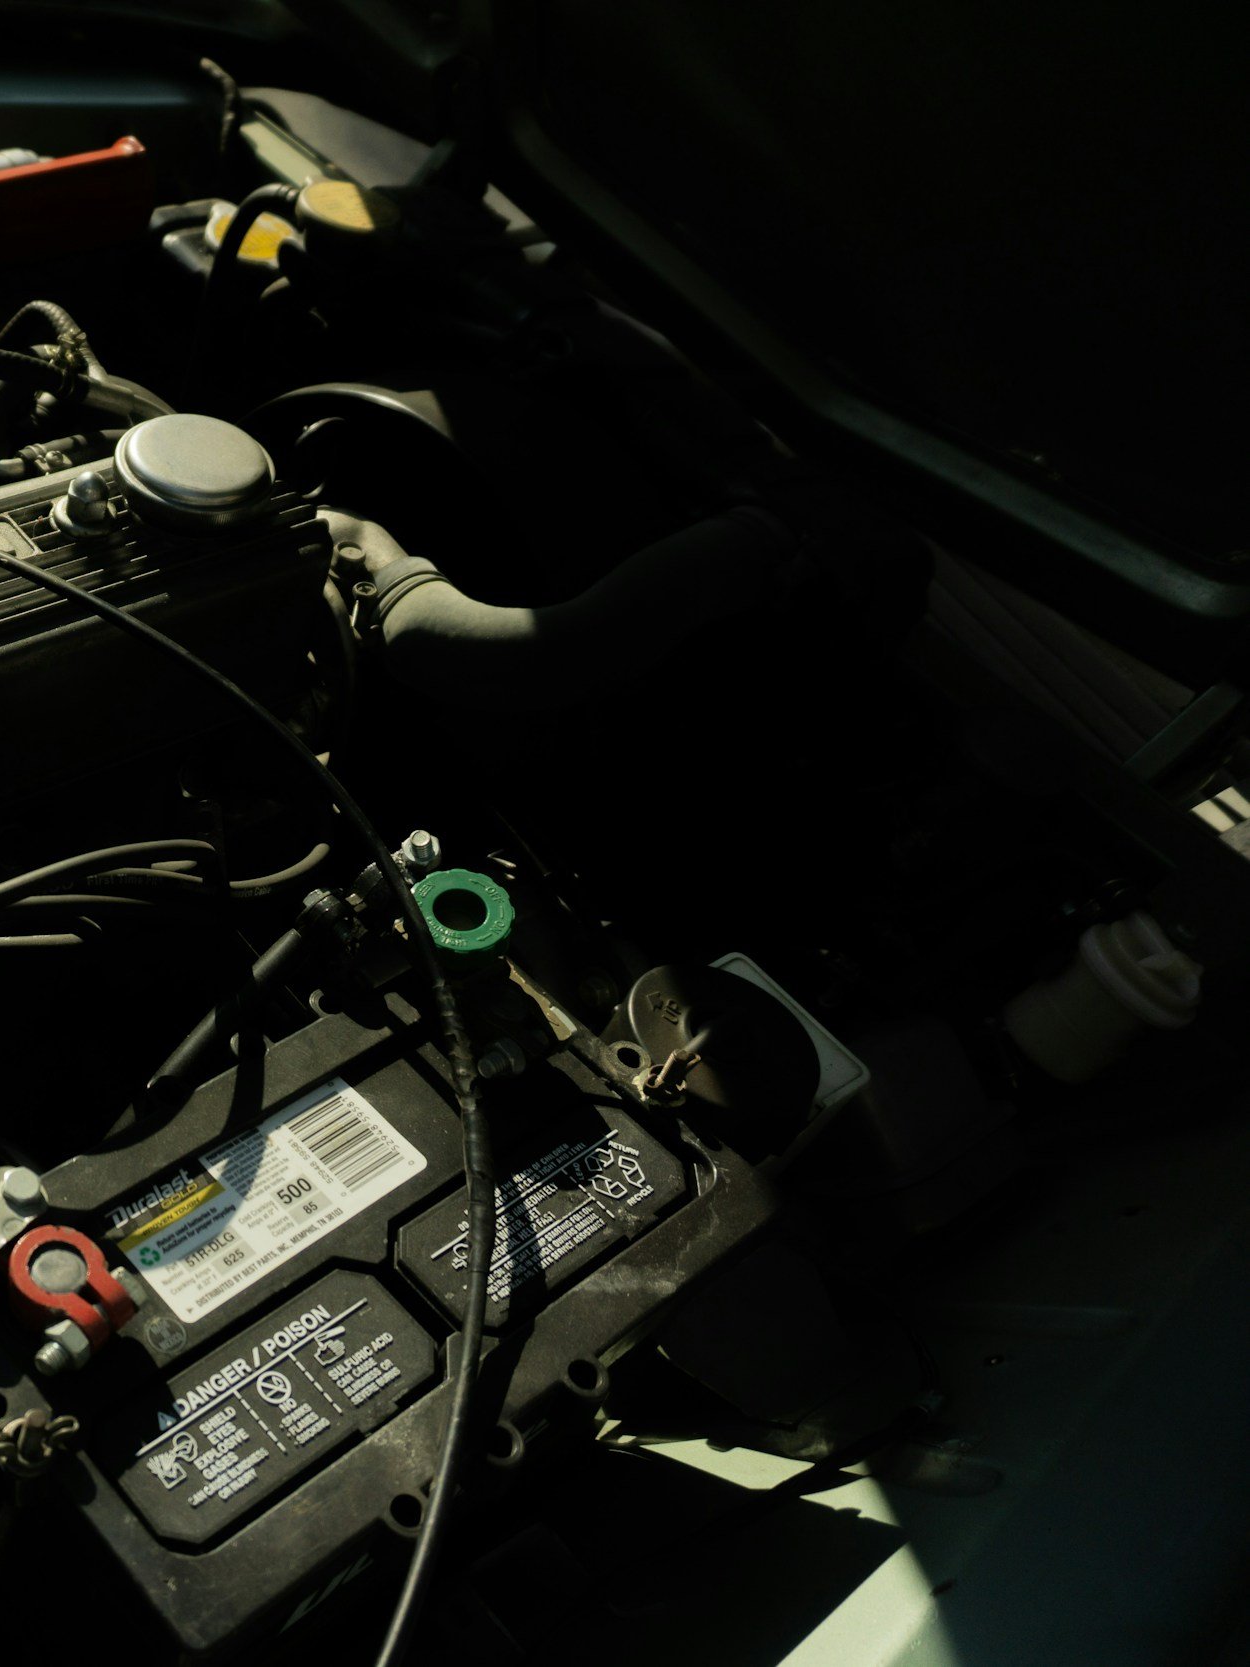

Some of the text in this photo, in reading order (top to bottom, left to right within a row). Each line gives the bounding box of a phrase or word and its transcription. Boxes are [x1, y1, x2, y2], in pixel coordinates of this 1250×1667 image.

[485, 886, 505, 904] OFF
[490, 919, 505, 934] ON
[661, 999, 681, 1026] UP
[340, 1095, 370, 1123] 59581
[369, 1122, 400, 1151] 52948
[607, 1140, 639, 1156] RETURN
[103, 1165, 195, 1231] Duralast
[159, 1181, 199, 1210] GOLD
[276, 1174, 313, 1206] 500
[511, 1180, 559, 1217] IMMEDIATELY
[626, 1183, 655, 1207] RECYCLE
[301, 1199, 319, 1215] 85
[524, 1206, 542, 1222] GET
[517, 1221, 539, 1241] HELP
[535, 1209, 556, 1229] FAST
[544, 1218, 573, 1242] STARTING
[184, 1229, 235, 1268] 51R-DLG
[195, 1278, 235, 1308] DISTRIBUTED
[232, 1272, 243, 1283] BY
[241, 1262, 257, 1277] BEST
[317, 1217, 327, 1227] TN
[324, 1206, 344, 1222] 38103
[221, 1247, 245, 1267] 625
[171, 1354, 252, 1419] DANGER
[260, 1302, 332, 1358] POISON
[326, 1330, 394, 1382] SULFURIC ACID
[335, 1355, 377, 1389] CAN CAUSE
[342, 1357, 394, 1398] BLINDNESS OR
[349, 1365, 401, 1406] SEVERE BURNS
[277, 1396, 298, 1414] NO
[198, 1404, 237, 1436] SHIELD
[206, 1419, 237, 1446] EYES
[287, 1410, 319, 1436] FLAMES
[295, 1415, 331, 1445] SMOKING
[193, 1426, 250, 1471] EXPLOSIVE
[201, 1449, 239, 1481] GASES
